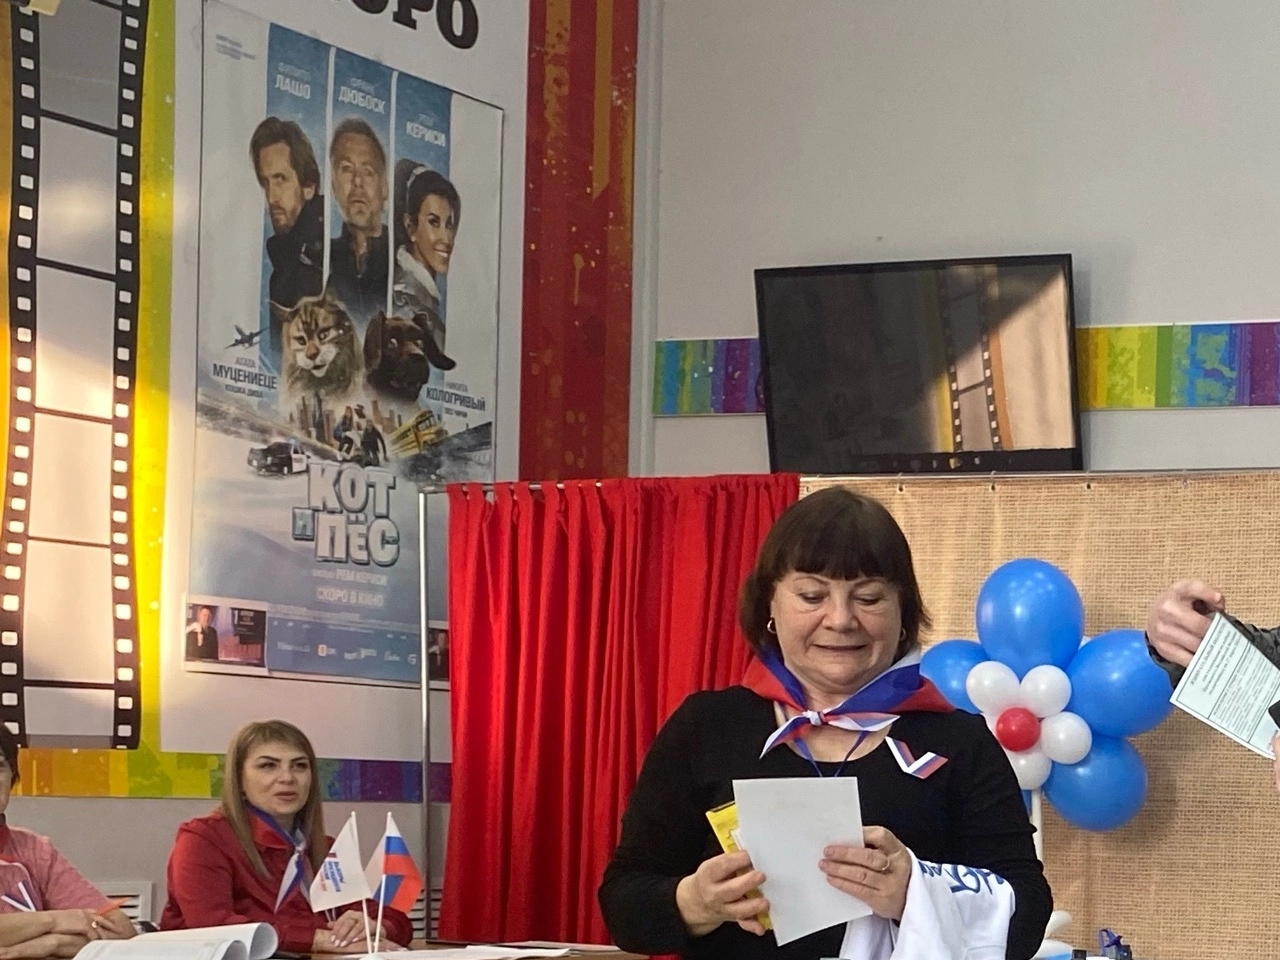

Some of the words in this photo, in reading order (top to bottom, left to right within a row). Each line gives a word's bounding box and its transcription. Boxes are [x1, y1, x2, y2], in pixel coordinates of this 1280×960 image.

[275, 74, 311, 100] ЛАШО
[338, 86, 386, 114] ДЮБОСК
[212, 363, 278, 391] МУЦЕНИЕЦЕ
[426, 387, 486, 412] КОЛОГРИВЫЙ
[307, 460, 396, 518] КОТ
